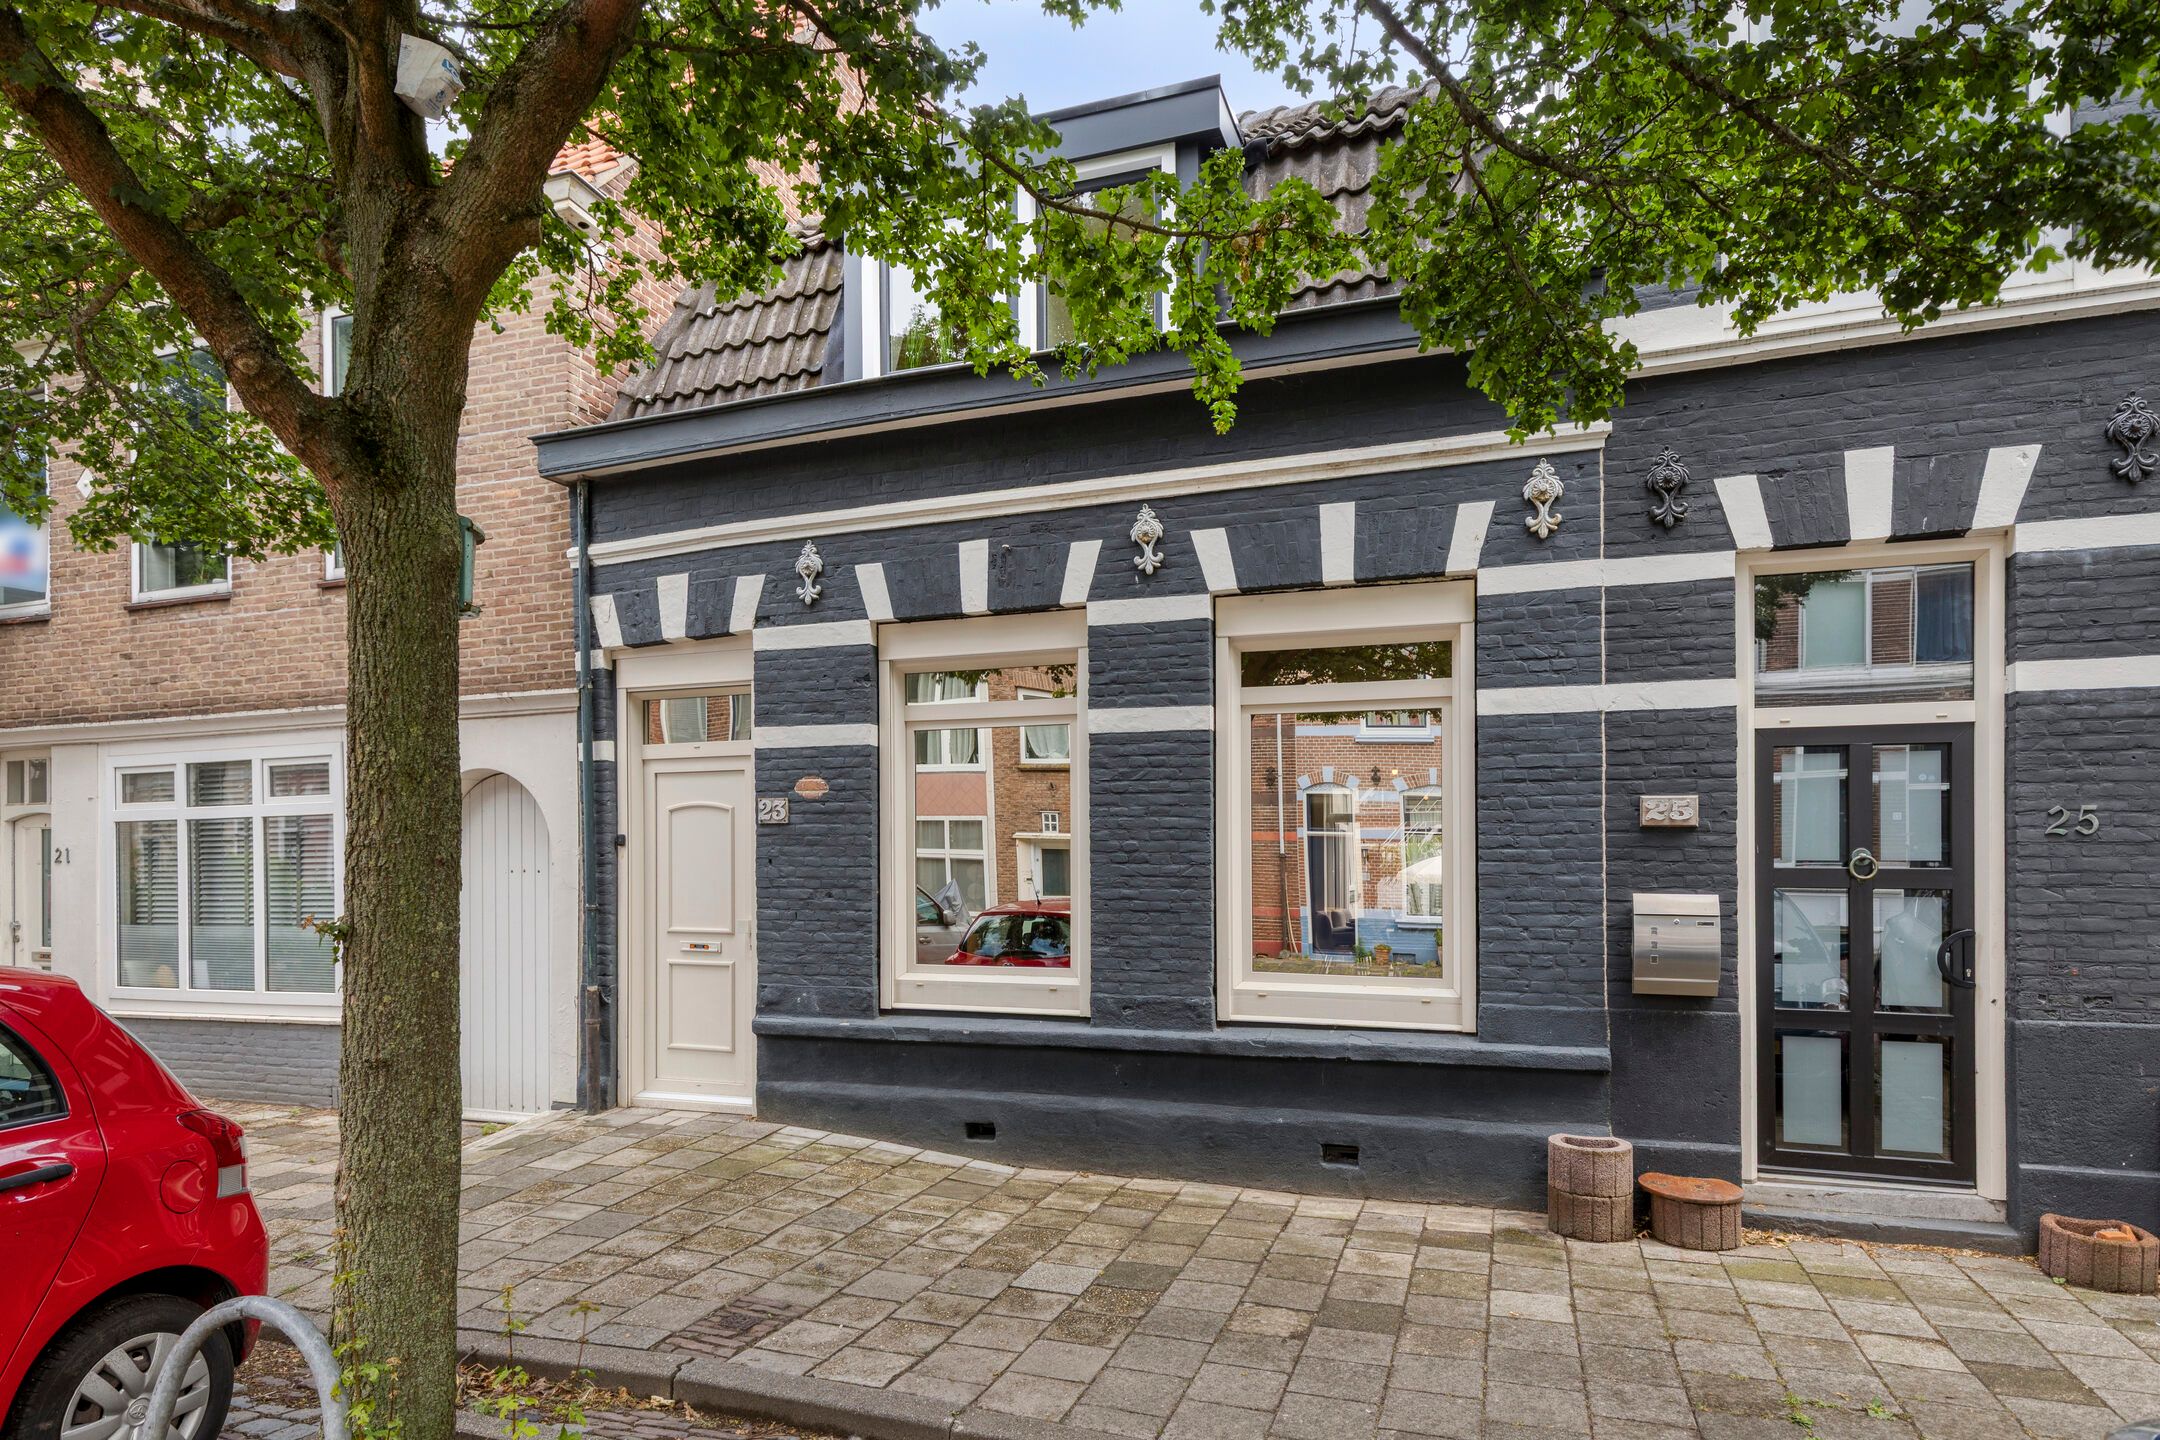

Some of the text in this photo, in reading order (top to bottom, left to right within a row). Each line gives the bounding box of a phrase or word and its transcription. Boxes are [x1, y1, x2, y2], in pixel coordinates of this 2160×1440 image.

[759, 799, 787, 821] 23
[1645, 799, 1694, 821] 25
[2044, 804, 2100, 836] 25
[54, 847, 71, 864] 21
